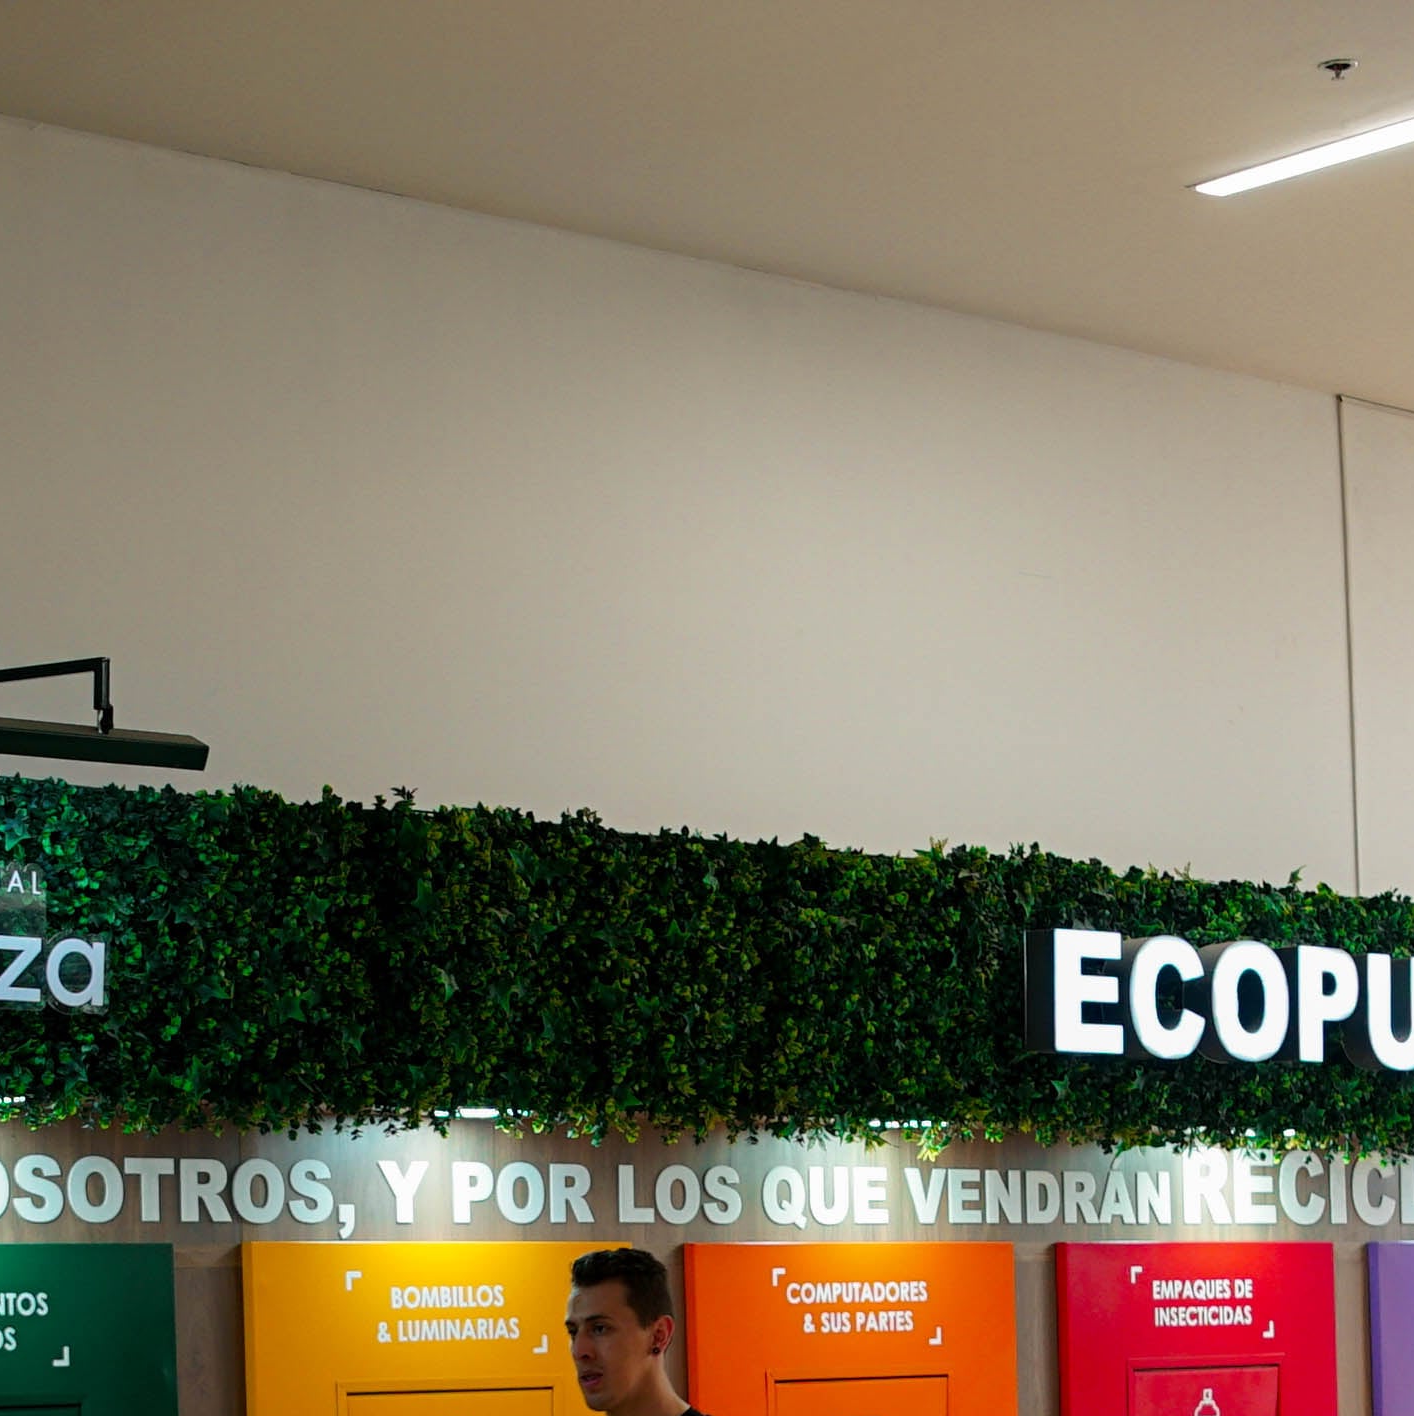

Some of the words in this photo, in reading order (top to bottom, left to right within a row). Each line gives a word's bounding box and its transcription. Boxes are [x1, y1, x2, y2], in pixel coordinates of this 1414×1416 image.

[377, 1160, 429, 1224] Y
[452, 1161, 595, 1225] POR
[617, 1164, 743, 1225] LOS
[761, 1165, 889, 1229] QUE
[904, 1151, 1173, 1225] VENDRÁN
[390, 1284, 505, 1310] BOMBILLOS
[786, 1281, 928, 1305] COMPUTADORES
[1152, 1279, 1231, 1301] EMPAQUES
[1234, 1278, 1254, 1300] DE
[802, 1312, 816, 1334] &
[820, 1311, 852, 1334] SUS
[855, 1310, 914, 1333] PARTES
[1154, 1305, 1254, 1328] INSECTICIDAS
[377, 1320, 392, 1344] &
[397, 1317, 521, 1343] LUMINARIAS
